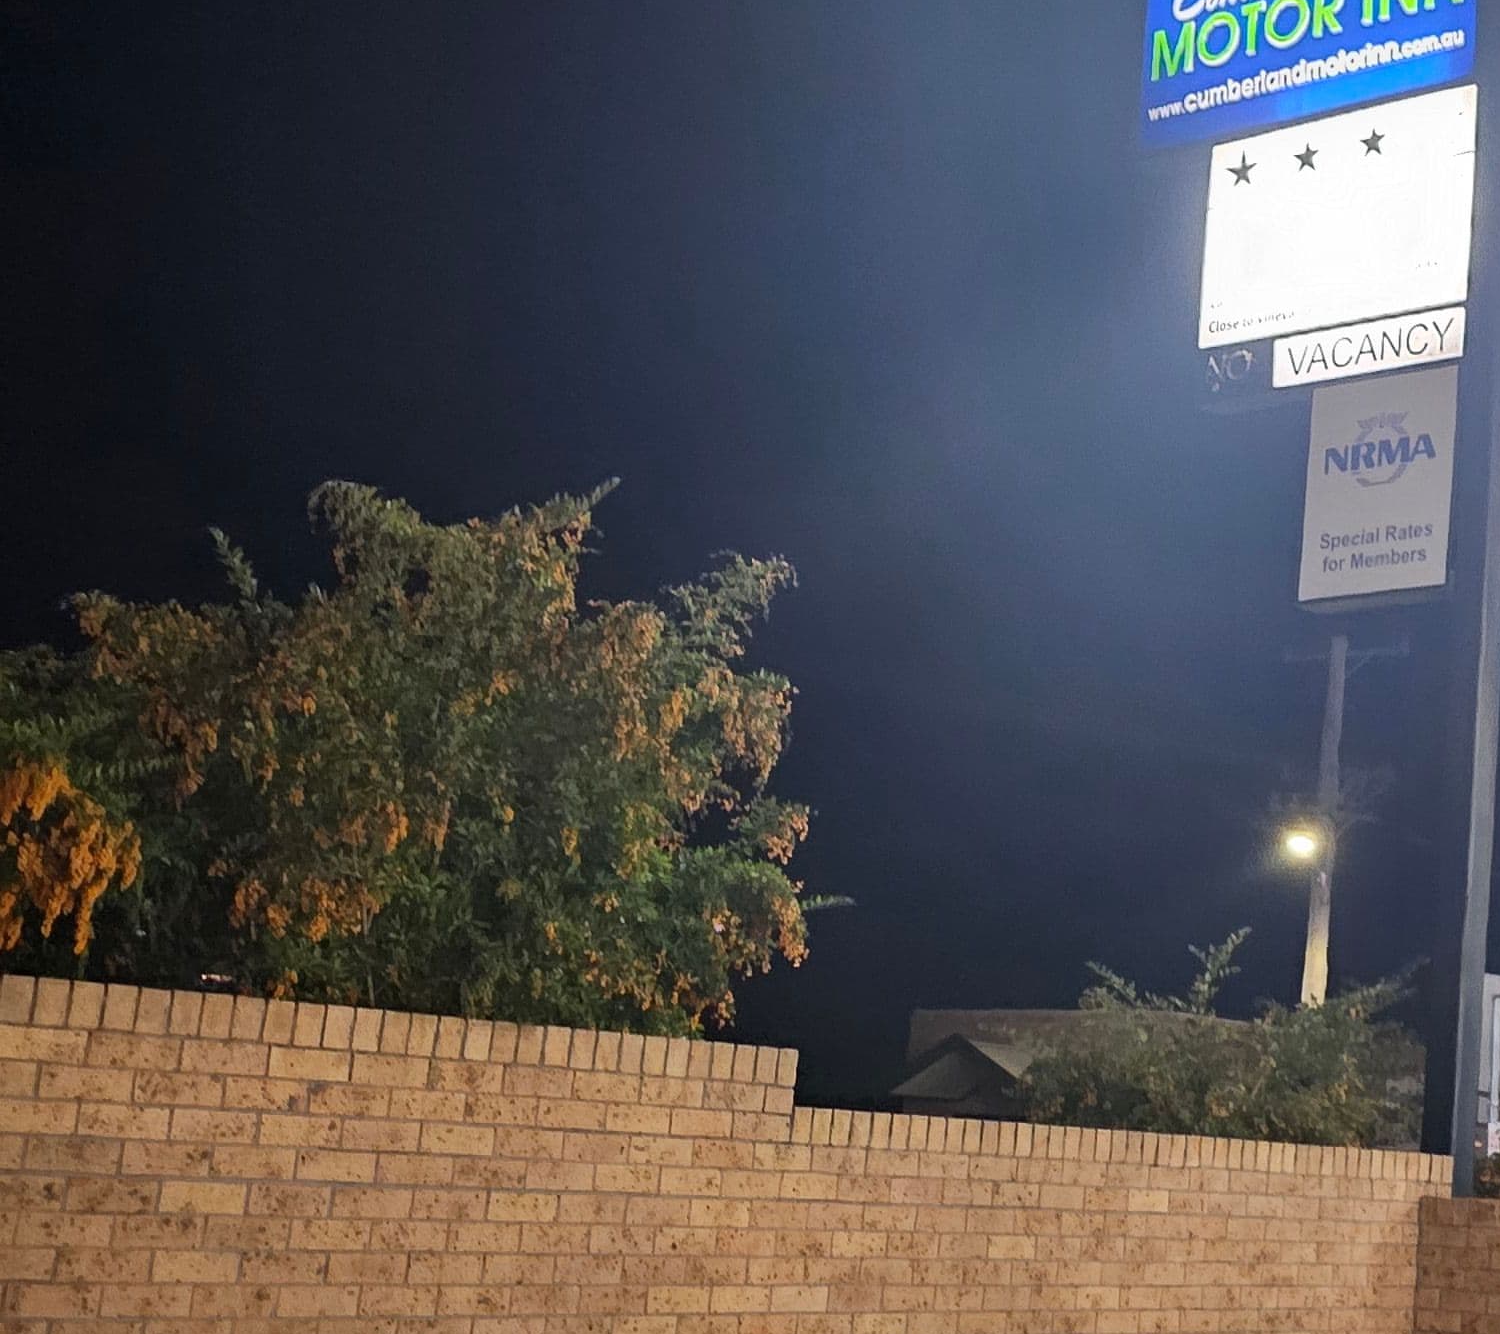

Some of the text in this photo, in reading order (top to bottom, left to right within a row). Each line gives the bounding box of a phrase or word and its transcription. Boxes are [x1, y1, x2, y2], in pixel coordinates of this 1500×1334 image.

[1147, 30, 1466, 122] www.cumberlandmotorinn.com.au
[1287, 317, 1454, 376] VACANCY
[1324, 434, 1437, 476] NRMA
[1319, 523, 1433, 551] Special Rates
[1322, 547, 1427, 573] for Members
